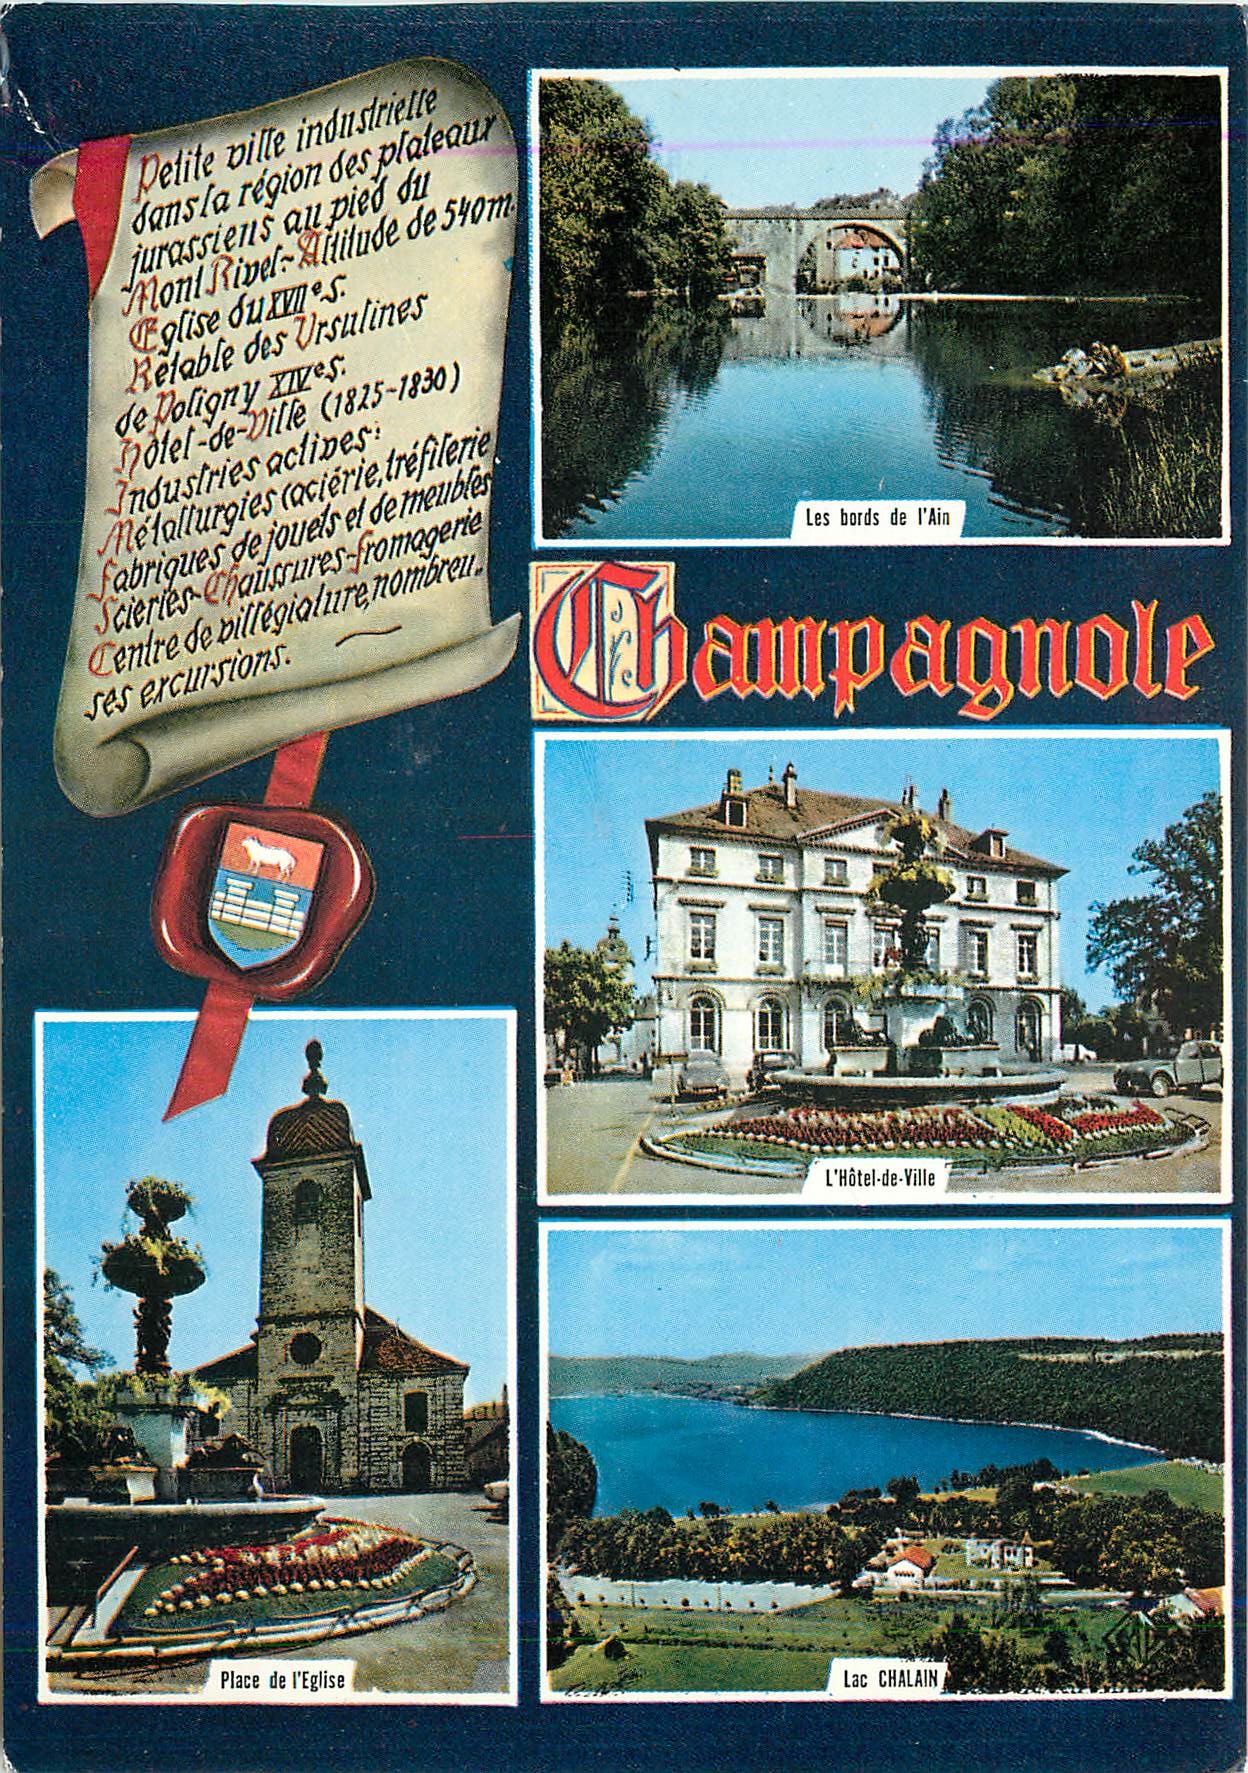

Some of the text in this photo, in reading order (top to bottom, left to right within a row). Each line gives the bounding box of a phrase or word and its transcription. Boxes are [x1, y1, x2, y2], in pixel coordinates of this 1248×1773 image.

[132, 87, 438, 203] Petite ville industrielle
[132, 114, 497, 235] dans la région des plateaux
[121, 167, 431, 294] jurassiens au pied du
[122, 264, 204, 317] Mont
[297, 213, 400, 268] Altitude
[406, 203, 438, 240] de
[125, 292, 428, 394] Retable des Ursulines
[129, 308, 221, 357] Eglise
[228, 292, 265, 329] du
[115, 401, 149, 438] de
[148, 379, 261, 436] Poligny
[97, 488, 277, 556] Métallurgies
[385, 426, 491, 482] tréfilerie
[104, 424, 380, 516] Industries actives:
[231, 528, 263, 562] de
[256, 502, 341, 567] jouets
[345, 496, 367, 532] et
[369, 492, 398, 525] de
[399, 463, 492, 518] meubles
[84, 642, 291, 722] ses excursions.
[88, 627, 180, 677] Centre
[185, 617, 213, 654] de
